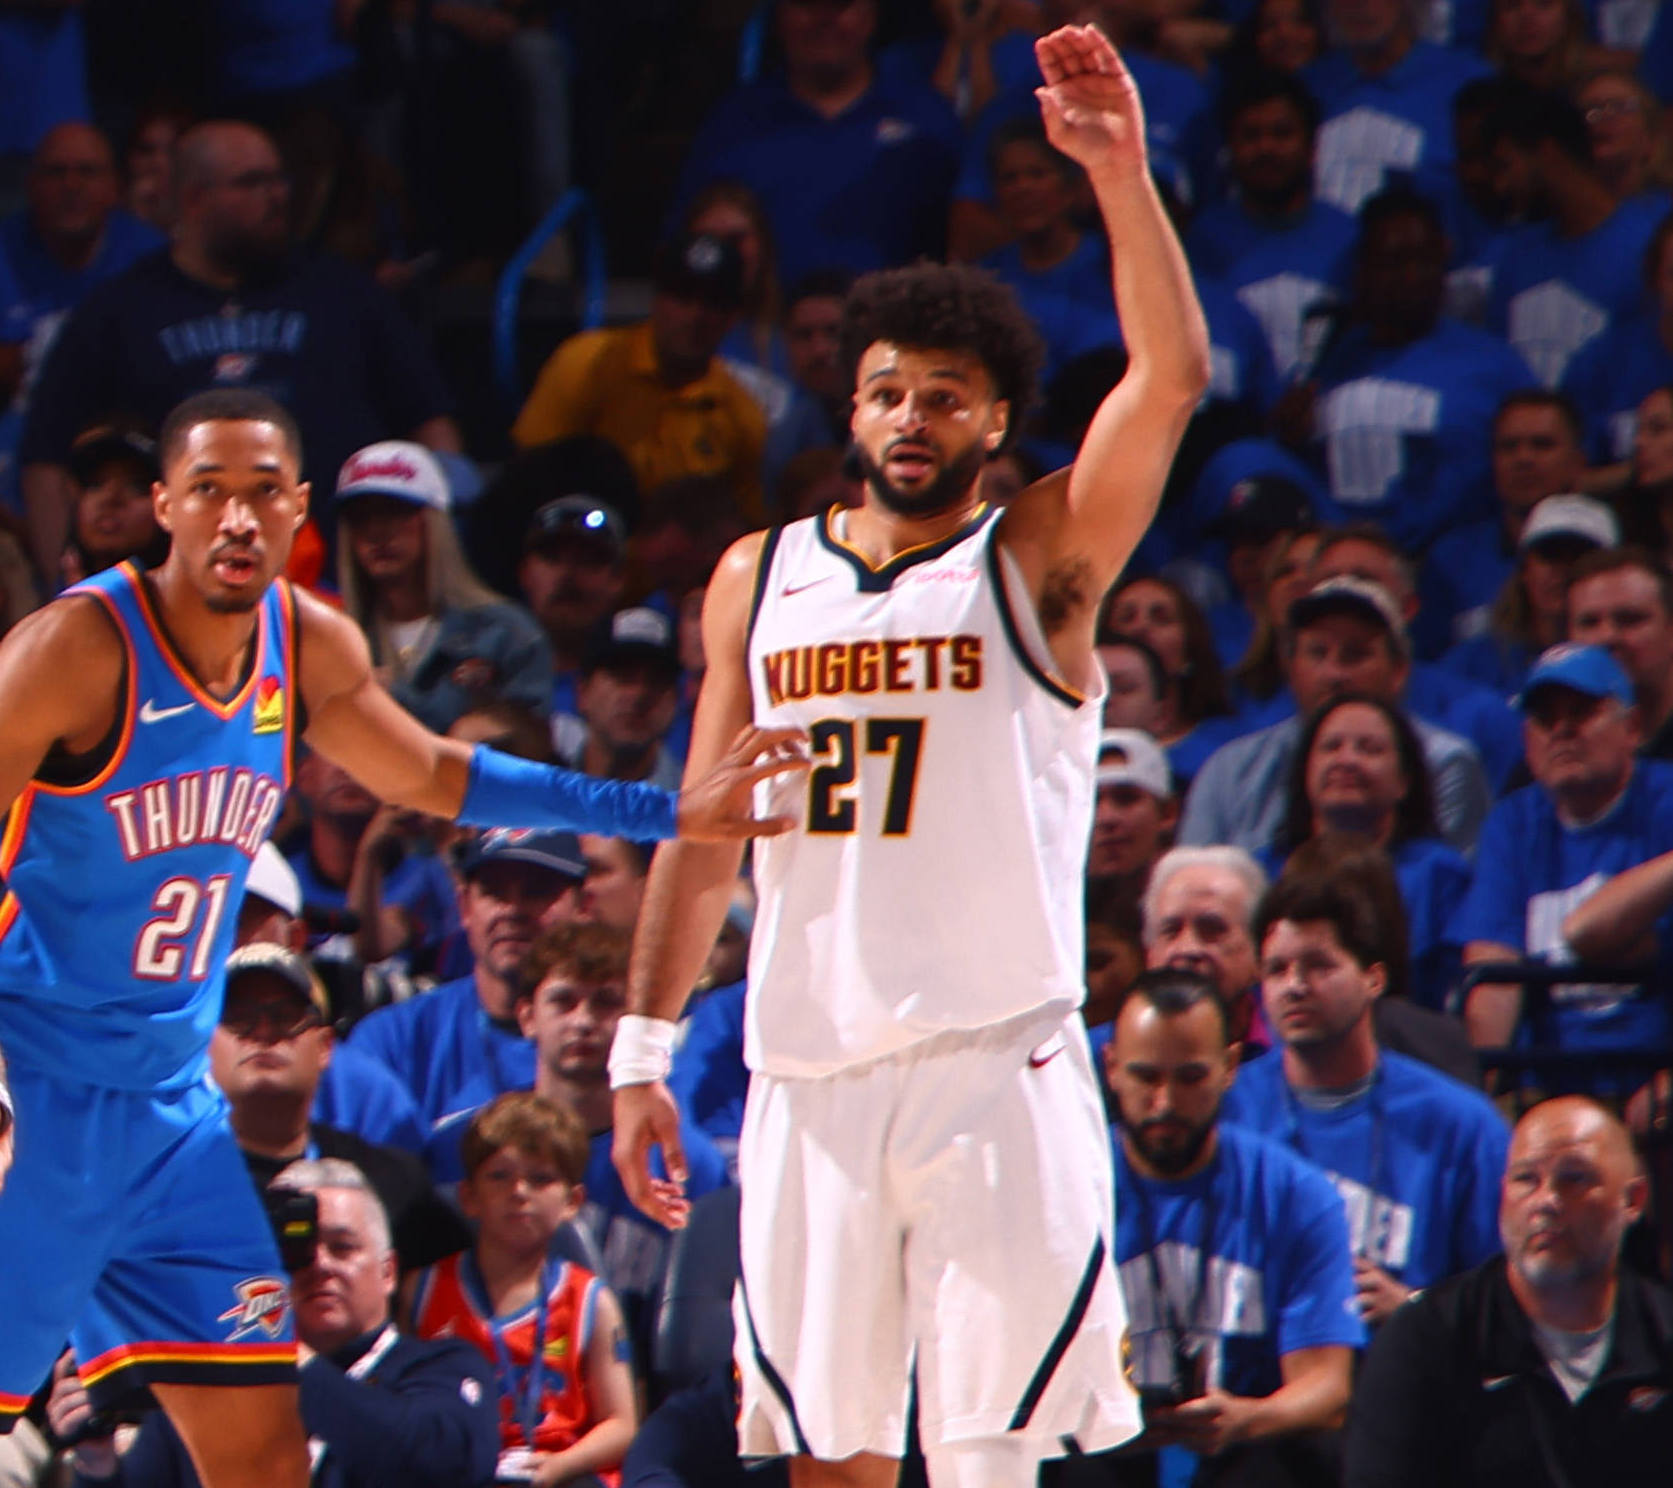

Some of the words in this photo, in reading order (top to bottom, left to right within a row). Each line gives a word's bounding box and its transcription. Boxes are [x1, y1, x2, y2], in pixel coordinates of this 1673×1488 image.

[762, 633, 984, 709] NUGGETS
[104, 764, 283, 863] THUNDER
[805, 717, 929, 839] 27
[131, 873, 234, 982] 21
